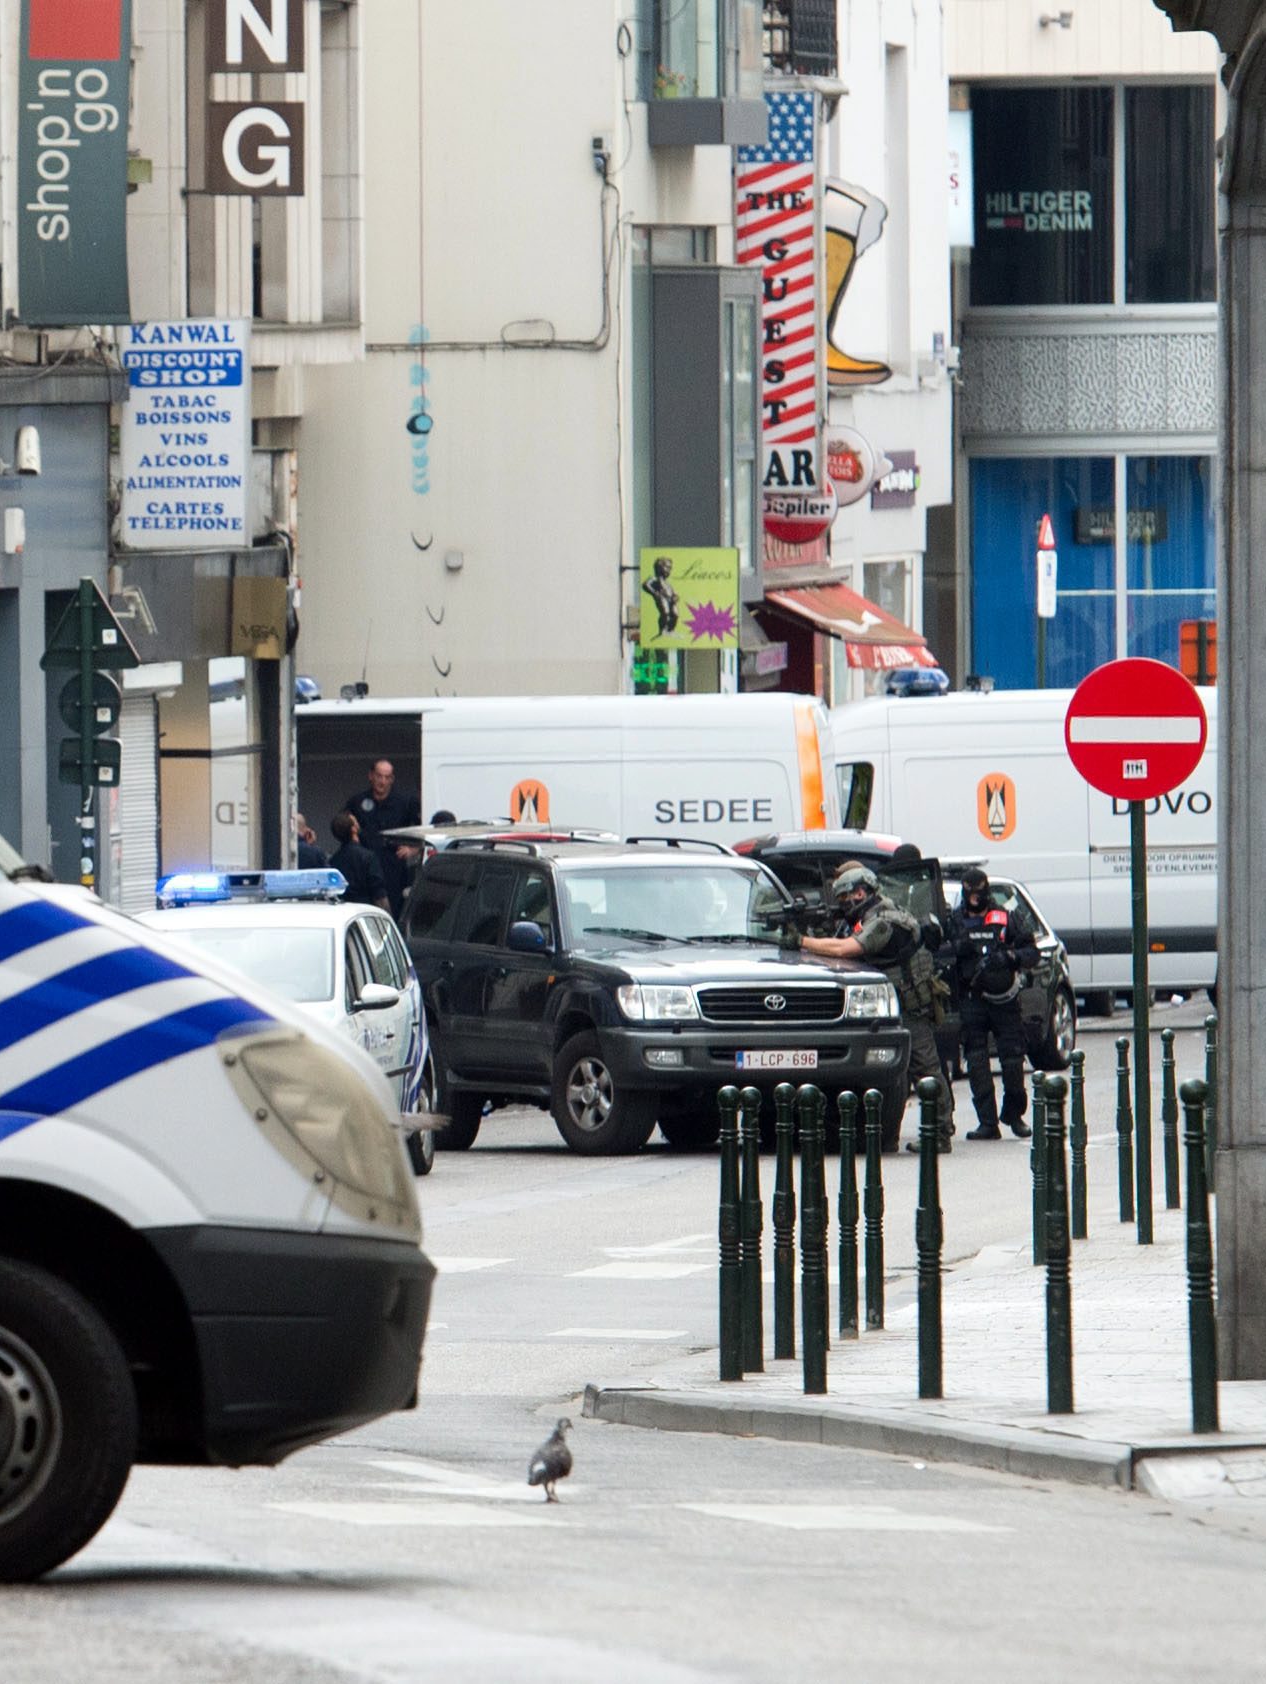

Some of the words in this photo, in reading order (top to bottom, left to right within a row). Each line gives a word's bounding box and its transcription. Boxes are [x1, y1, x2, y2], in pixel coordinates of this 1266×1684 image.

[75, 68, 118, 131] go
[28, 69, 80, 241] shop'n
[746, 192, 805, 210] THE
[986, 191, 1092, 213] HILFIGER
[1024, 212, 1093, 231] DENIM
[130, 324, 235, 344] KANWAL
[126, 353, 239, 368] DISCOUNT
[138, 370, 227, 385] SHOP
[151, 395, 216, 408] TABAC
[136, 411, 231, 425] BOISSONS
[160, 433, 208, 446] VINS
[139, 454, 229, 468] ALCOOLS
[762, 450, 816, 486] AR
[127, 475, 242, 490] ALIMENTATION
[146, 502, 224, 515] CARTES
[128, 517, 242, 530] TELEPHONE
[655, 799, 773, 823] SEDEE
